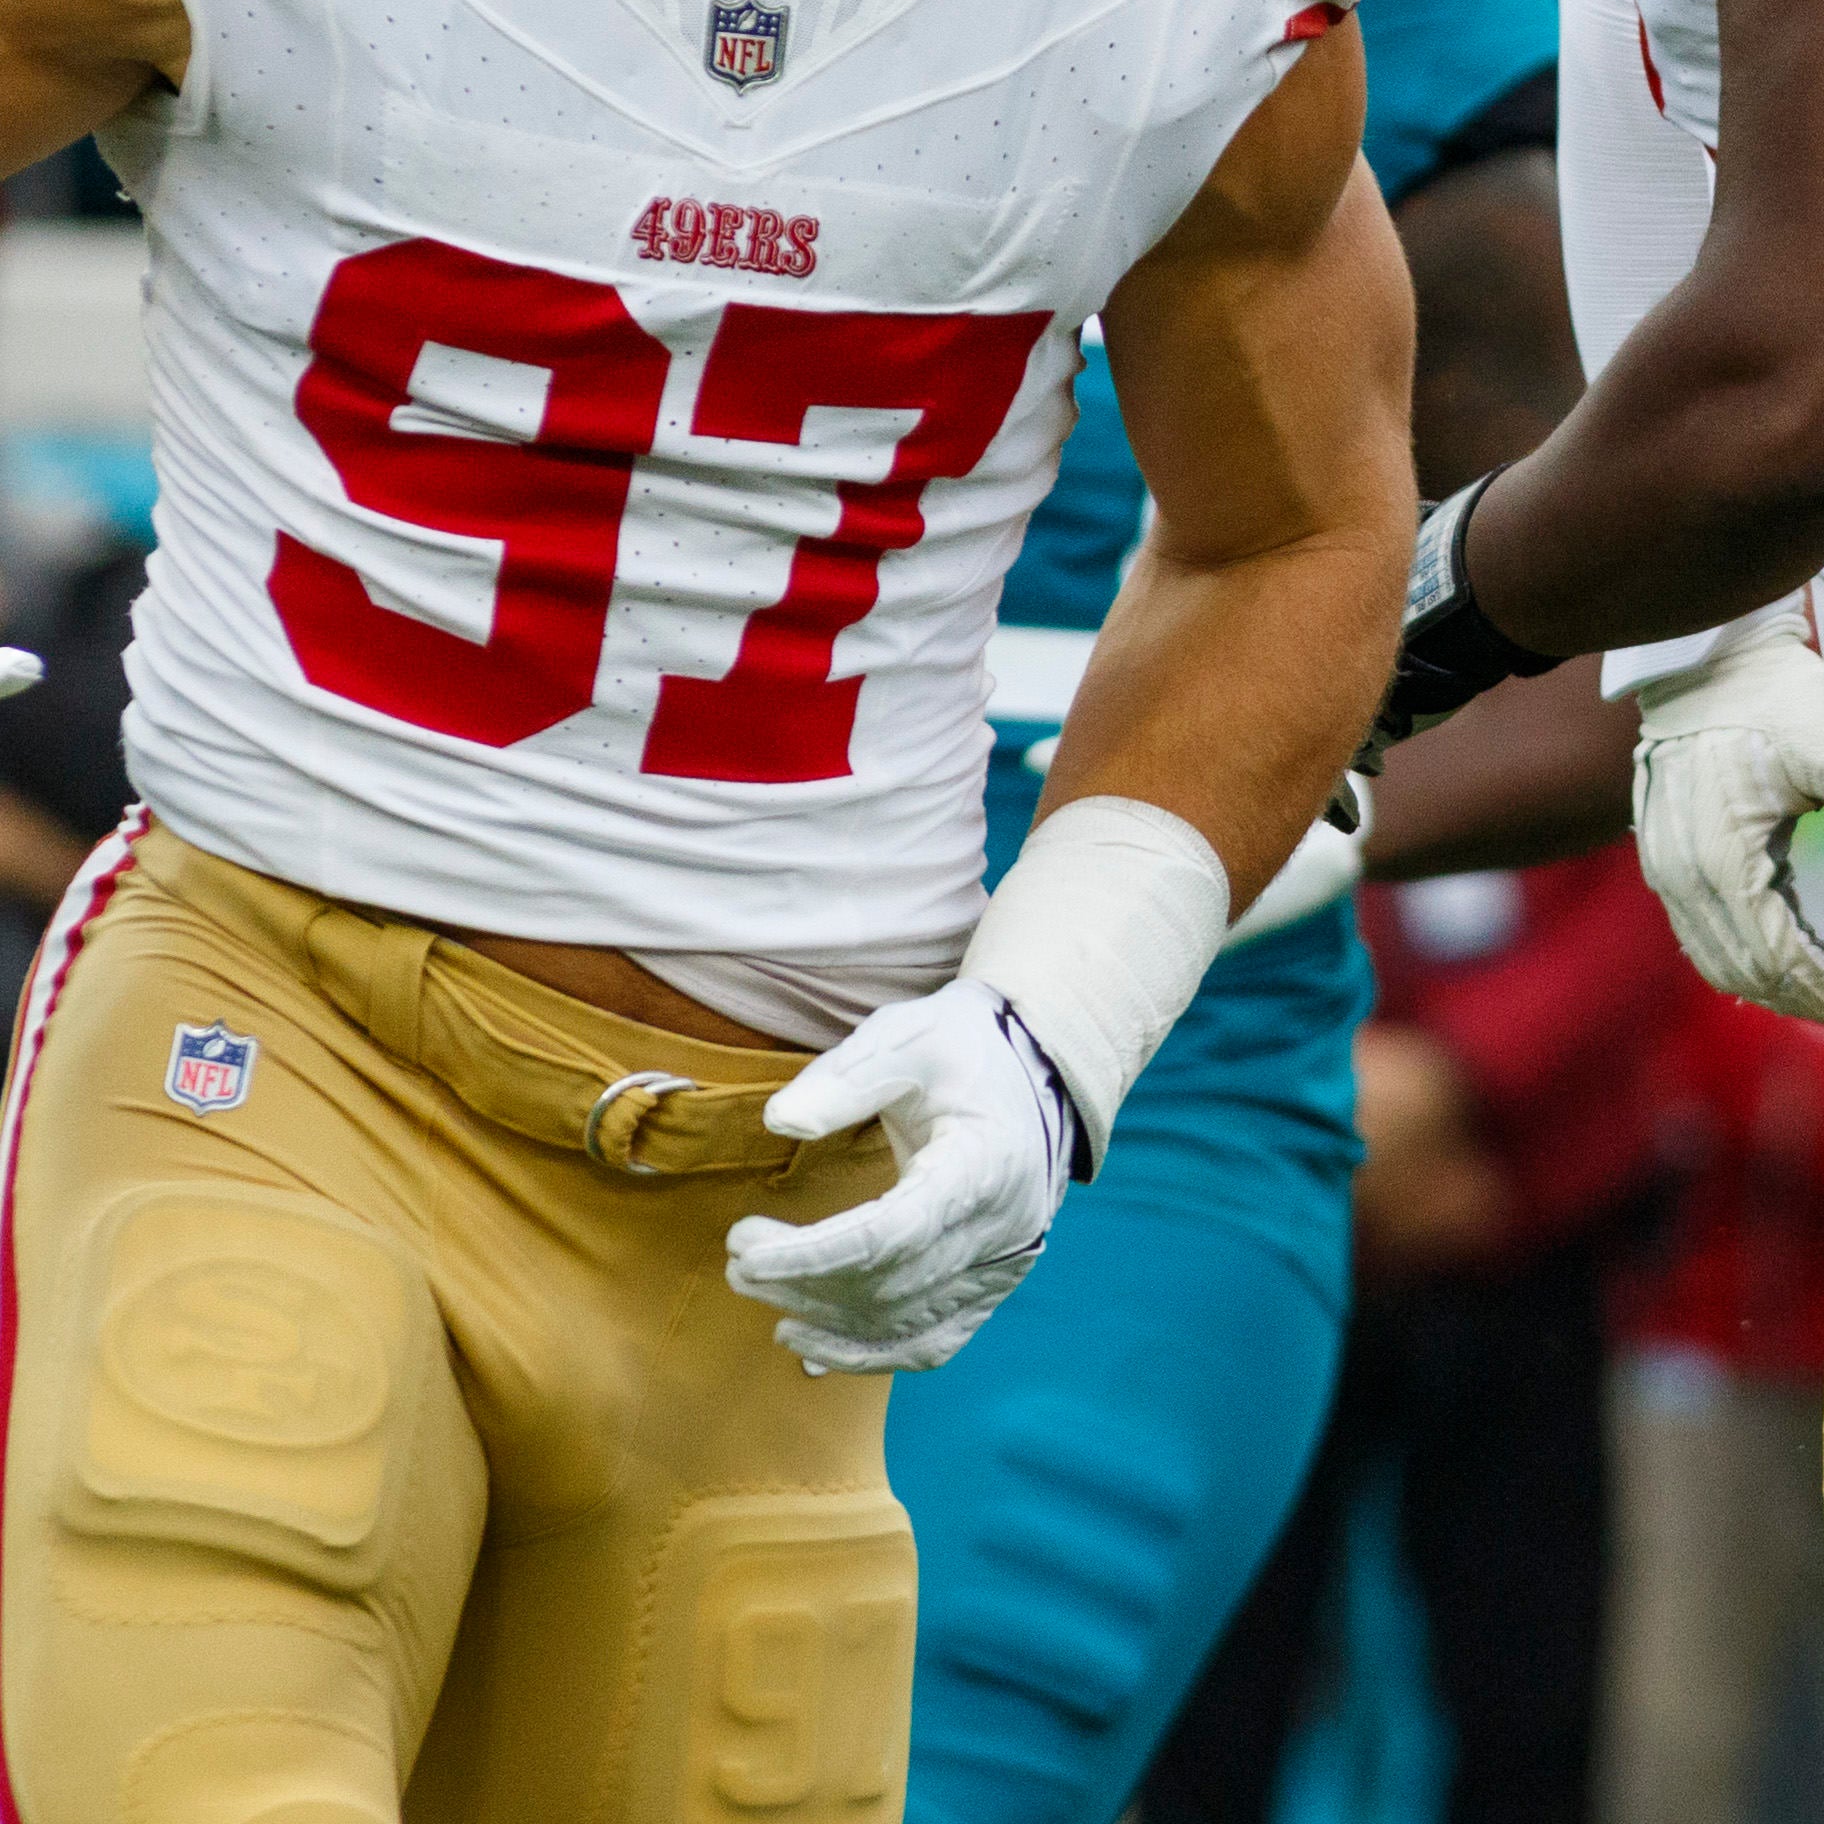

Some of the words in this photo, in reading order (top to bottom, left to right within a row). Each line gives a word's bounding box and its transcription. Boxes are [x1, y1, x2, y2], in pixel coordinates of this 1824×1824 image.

[716, 35, 773, 76] NFL
[630, 196, 820, 279] 49ERS
[265, 236, 1055, 784] 97
[177, 1060, 234, 1097] NFL
